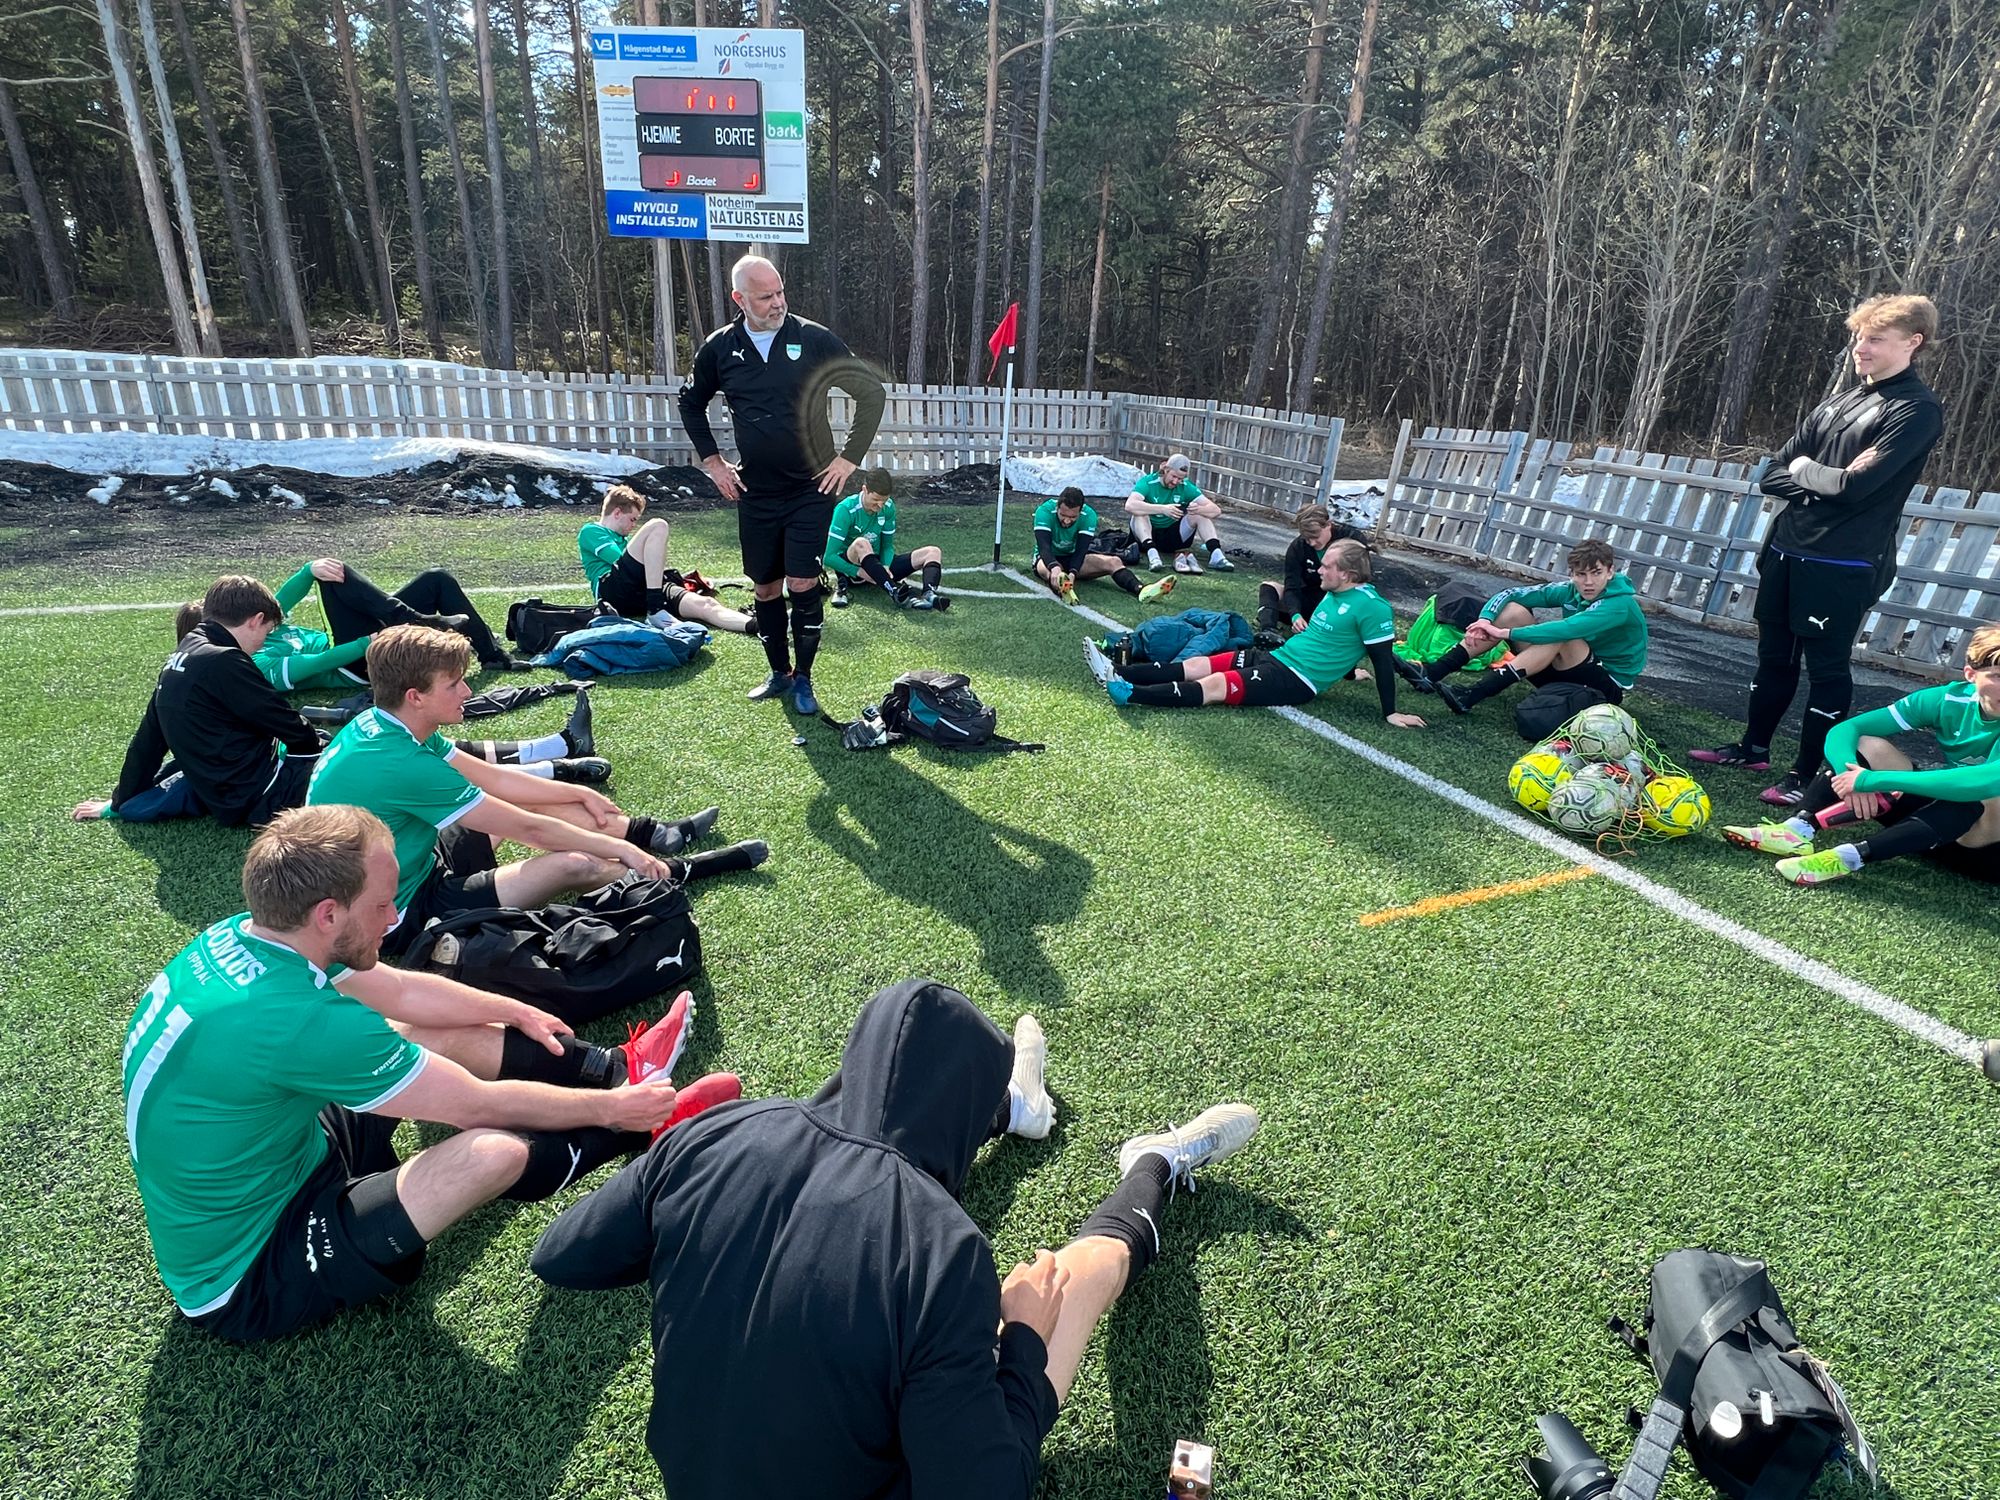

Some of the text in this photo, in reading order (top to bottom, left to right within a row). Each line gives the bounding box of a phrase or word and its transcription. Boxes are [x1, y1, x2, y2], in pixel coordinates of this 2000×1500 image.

[623, 44, 661, 55] Hågenstad
[675, 46, 686, 54] AS
[714, 44, 786, 58] NORGESHUS
[641, 125, 756, 146] HJEMME BORTE
[768, 123, 802, 138] bark.
[686, 174, 717, 187] Bodet
[633, 201, 679, 214] NYVOLD
[708, 196, 755, 209] Norheim
[616, 214, 698, 228] INSTALLASJON
[709, 210, 804, 227] NATURSTEN AS
[206, 917, 268, 986] DOMUS
[187, 950, 212, 986] OPPDAL
